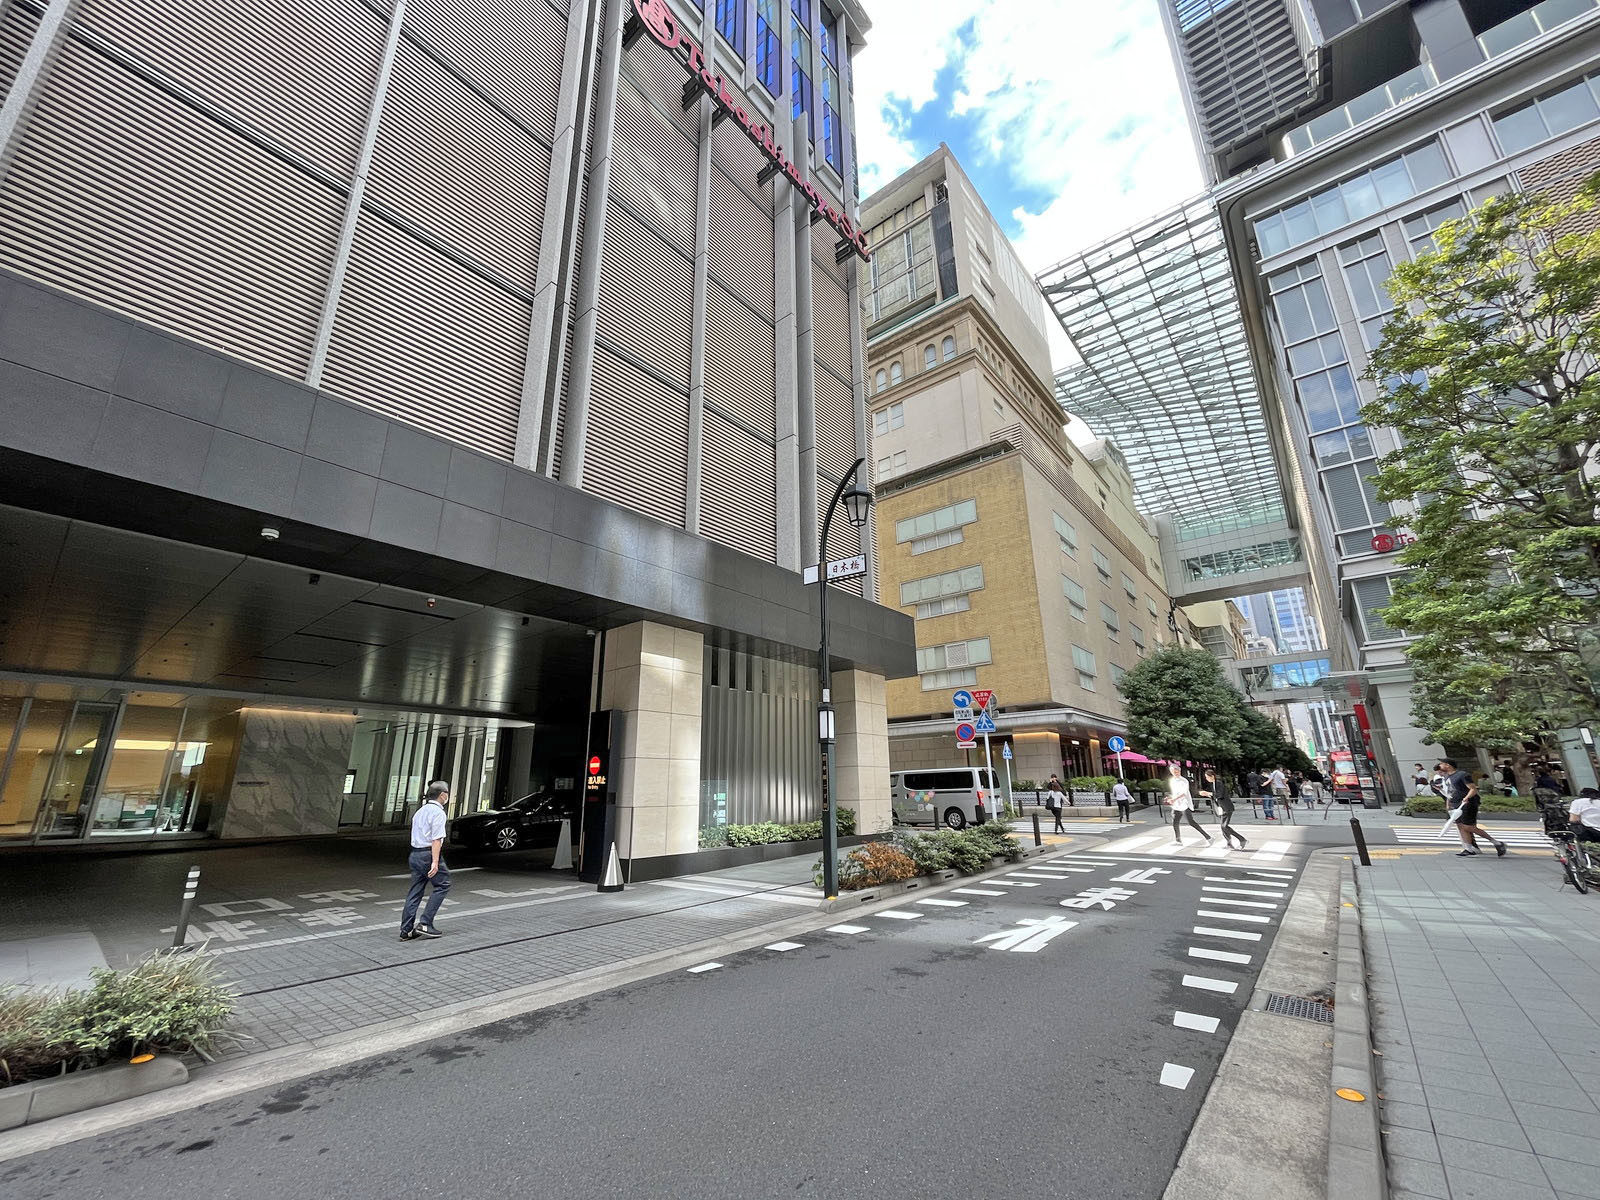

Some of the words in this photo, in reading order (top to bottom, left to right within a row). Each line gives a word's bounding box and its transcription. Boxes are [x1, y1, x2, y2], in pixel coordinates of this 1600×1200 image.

[682, 35, 839, 226] Takashimaya
[832, 560, 860, 573] 日本橋
[973, 867, 1172, 953] 止まれ
